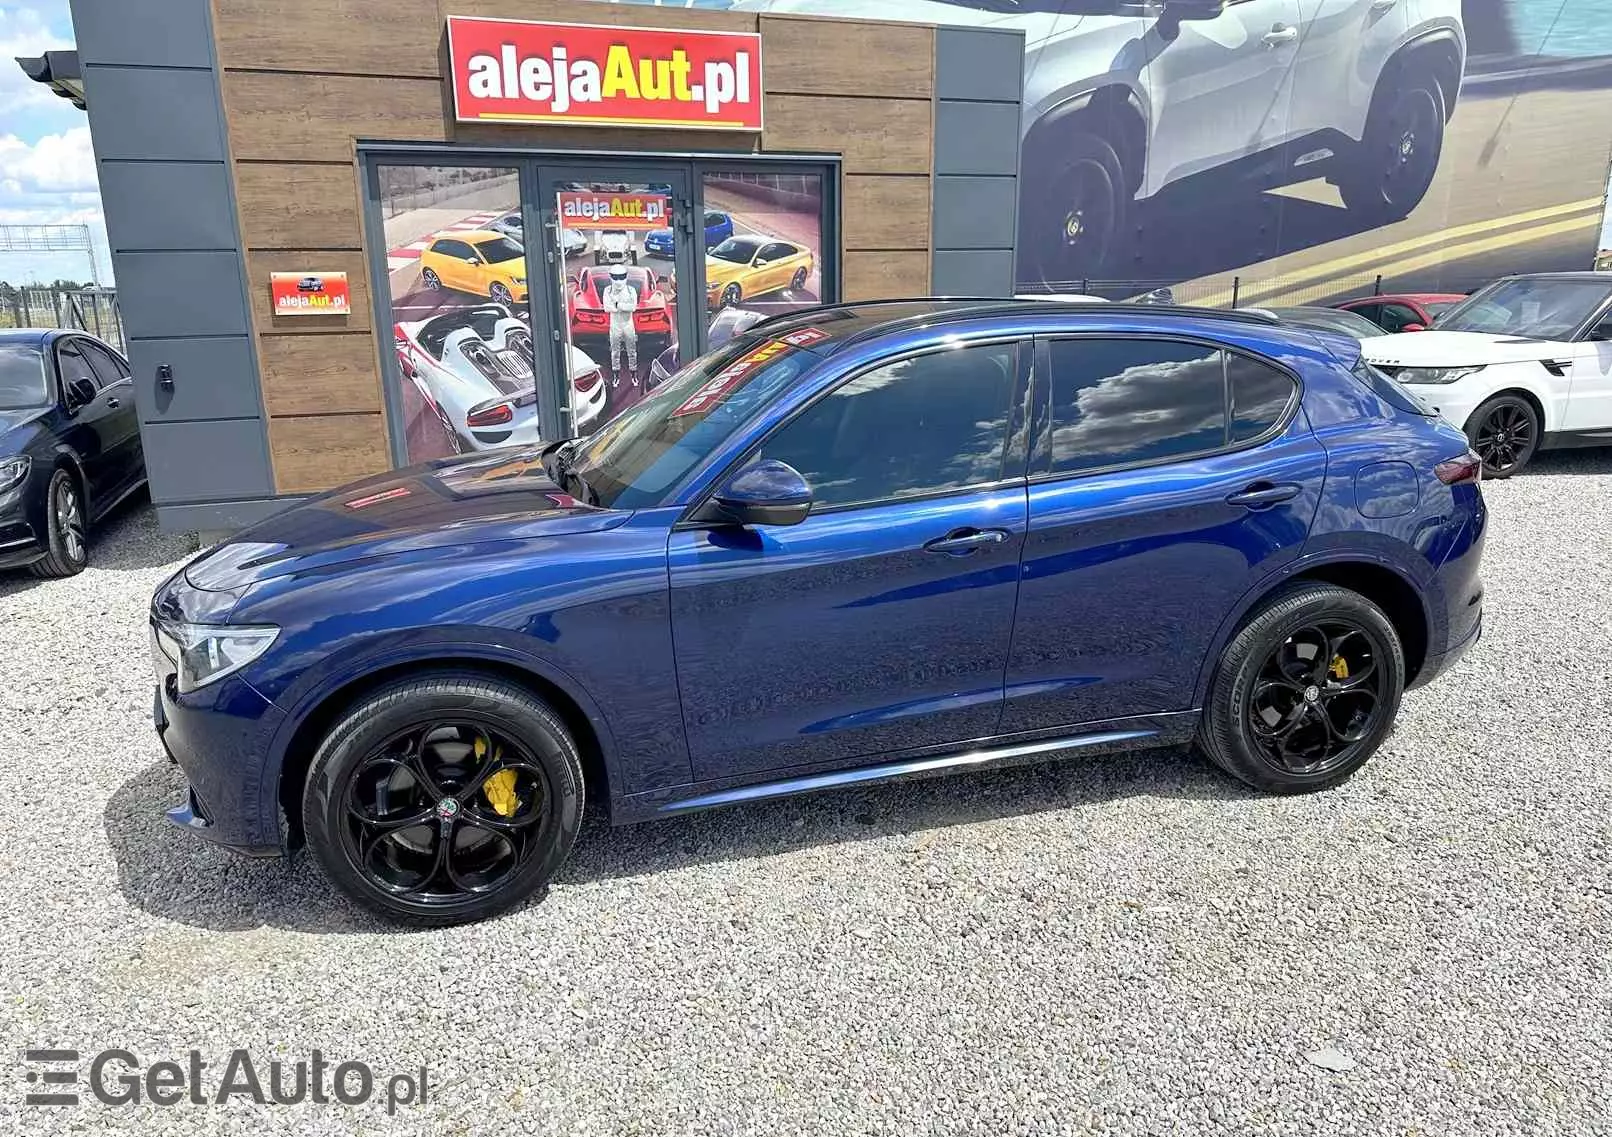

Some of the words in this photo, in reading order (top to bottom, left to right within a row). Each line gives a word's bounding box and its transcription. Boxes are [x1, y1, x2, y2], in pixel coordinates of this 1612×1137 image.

[467, 43, 751, 113] alejaAut.pl
[563, 197, 664, 222] alejaAut.pl
[278, 294, 345, 309] alejaAut.pl
